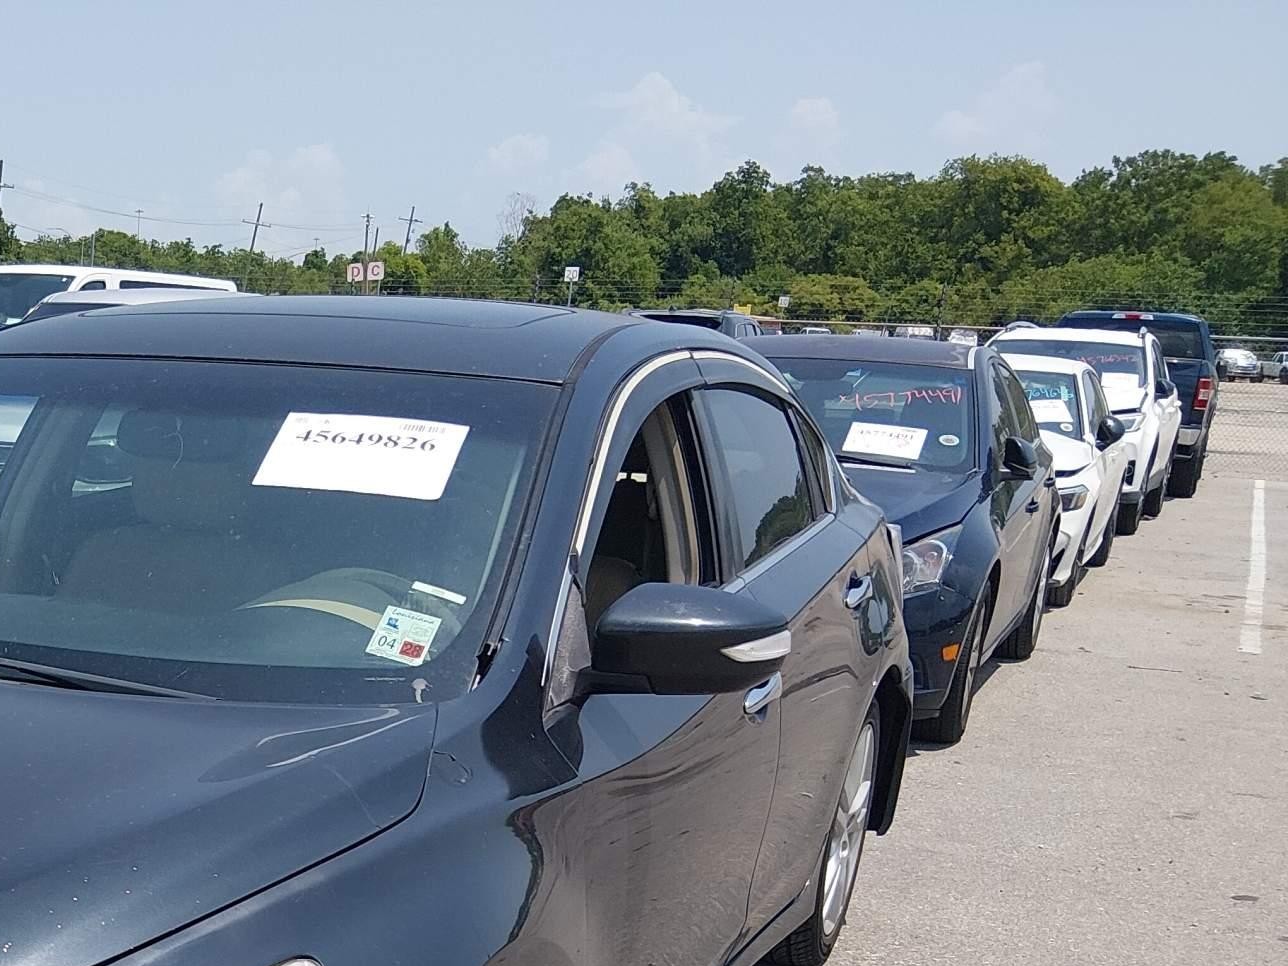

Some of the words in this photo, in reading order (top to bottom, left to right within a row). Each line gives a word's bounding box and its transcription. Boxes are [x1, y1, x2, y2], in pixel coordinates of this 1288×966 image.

[351, 266, 361, 278] D
[371, 264, 381, 277] C
[566, 269, 578, 280] 20
[295, 429, 437, 453] 45649826
[377, 635, 397, 650] 04
